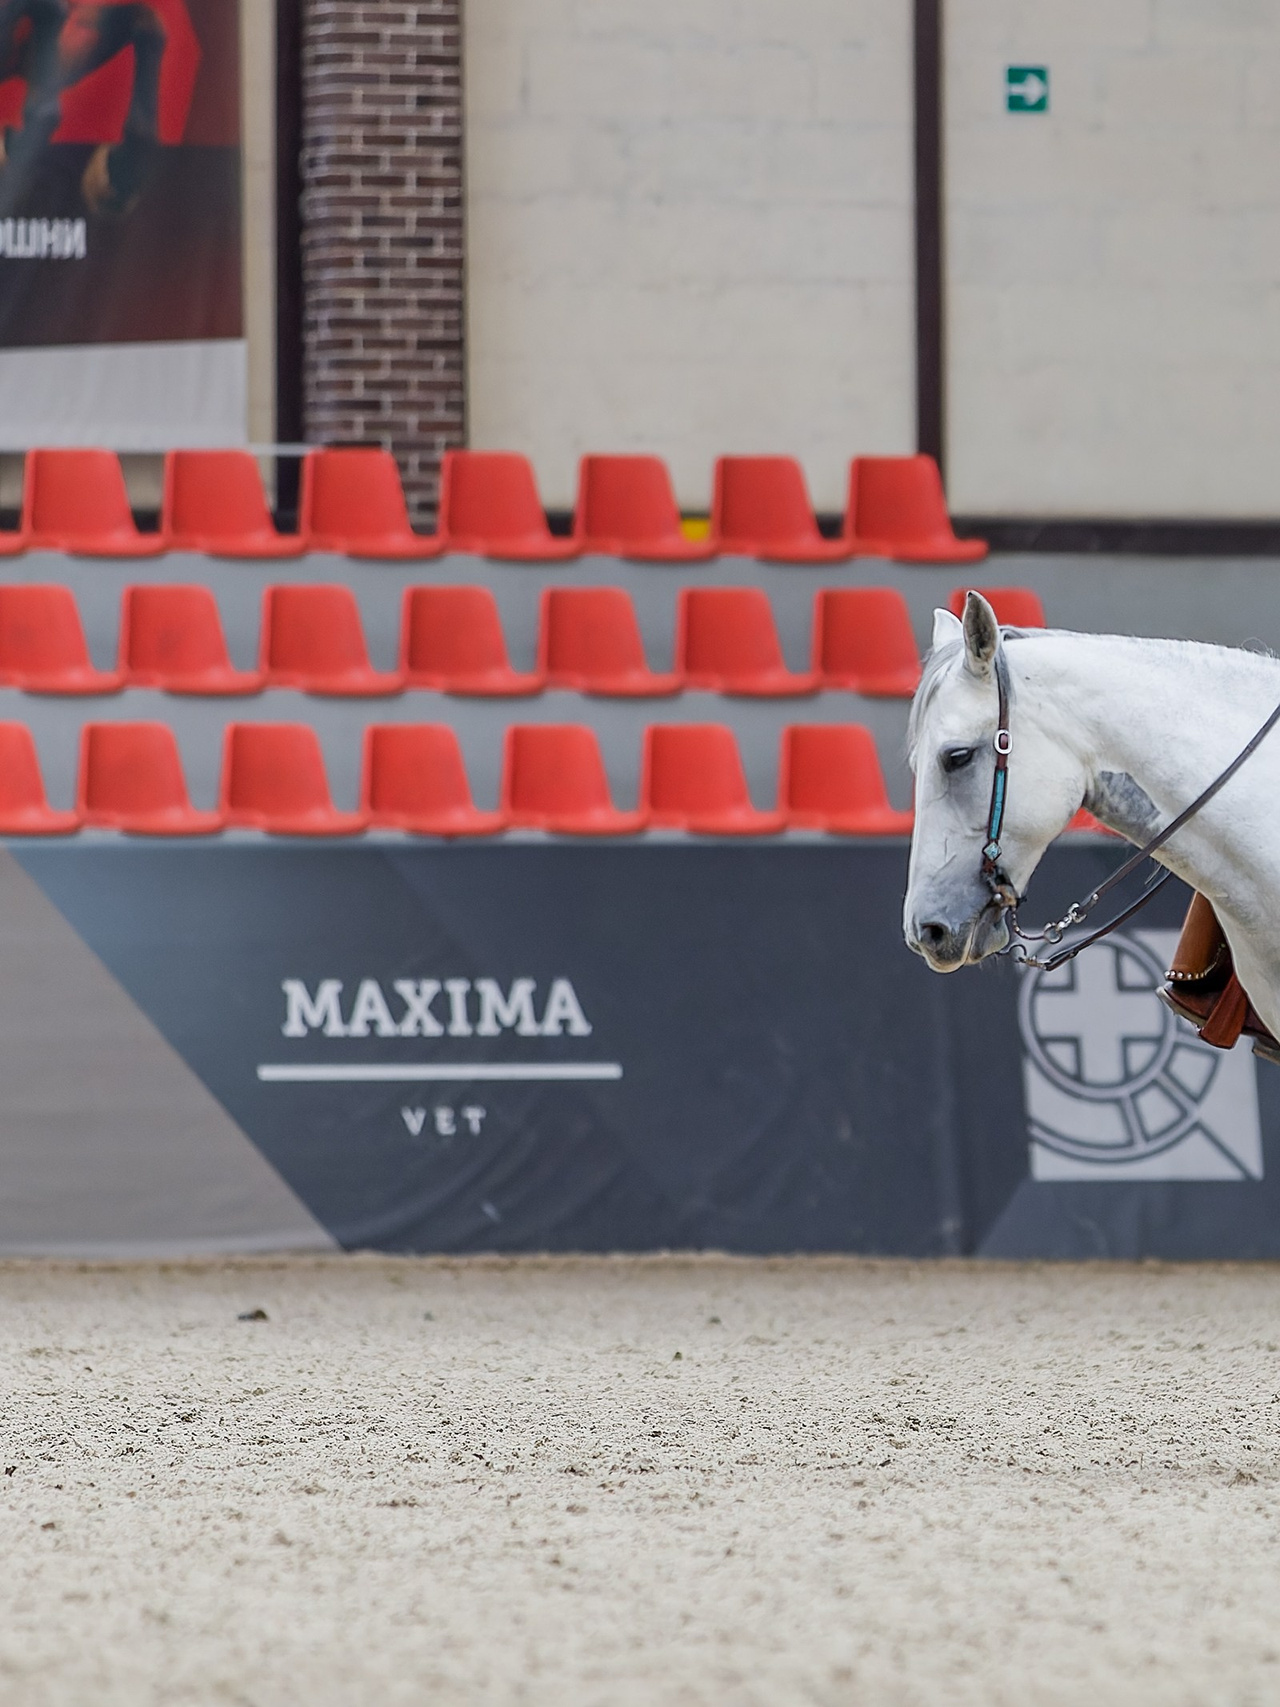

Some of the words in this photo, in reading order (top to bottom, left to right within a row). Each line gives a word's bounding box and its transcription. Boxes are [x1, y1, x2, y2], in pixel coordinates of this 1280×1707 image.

[0, 217, 86, 259] ШНИ
[282, 978, 593, 1037] MAXIMA
[402, 1106, 487, 1136] VET
